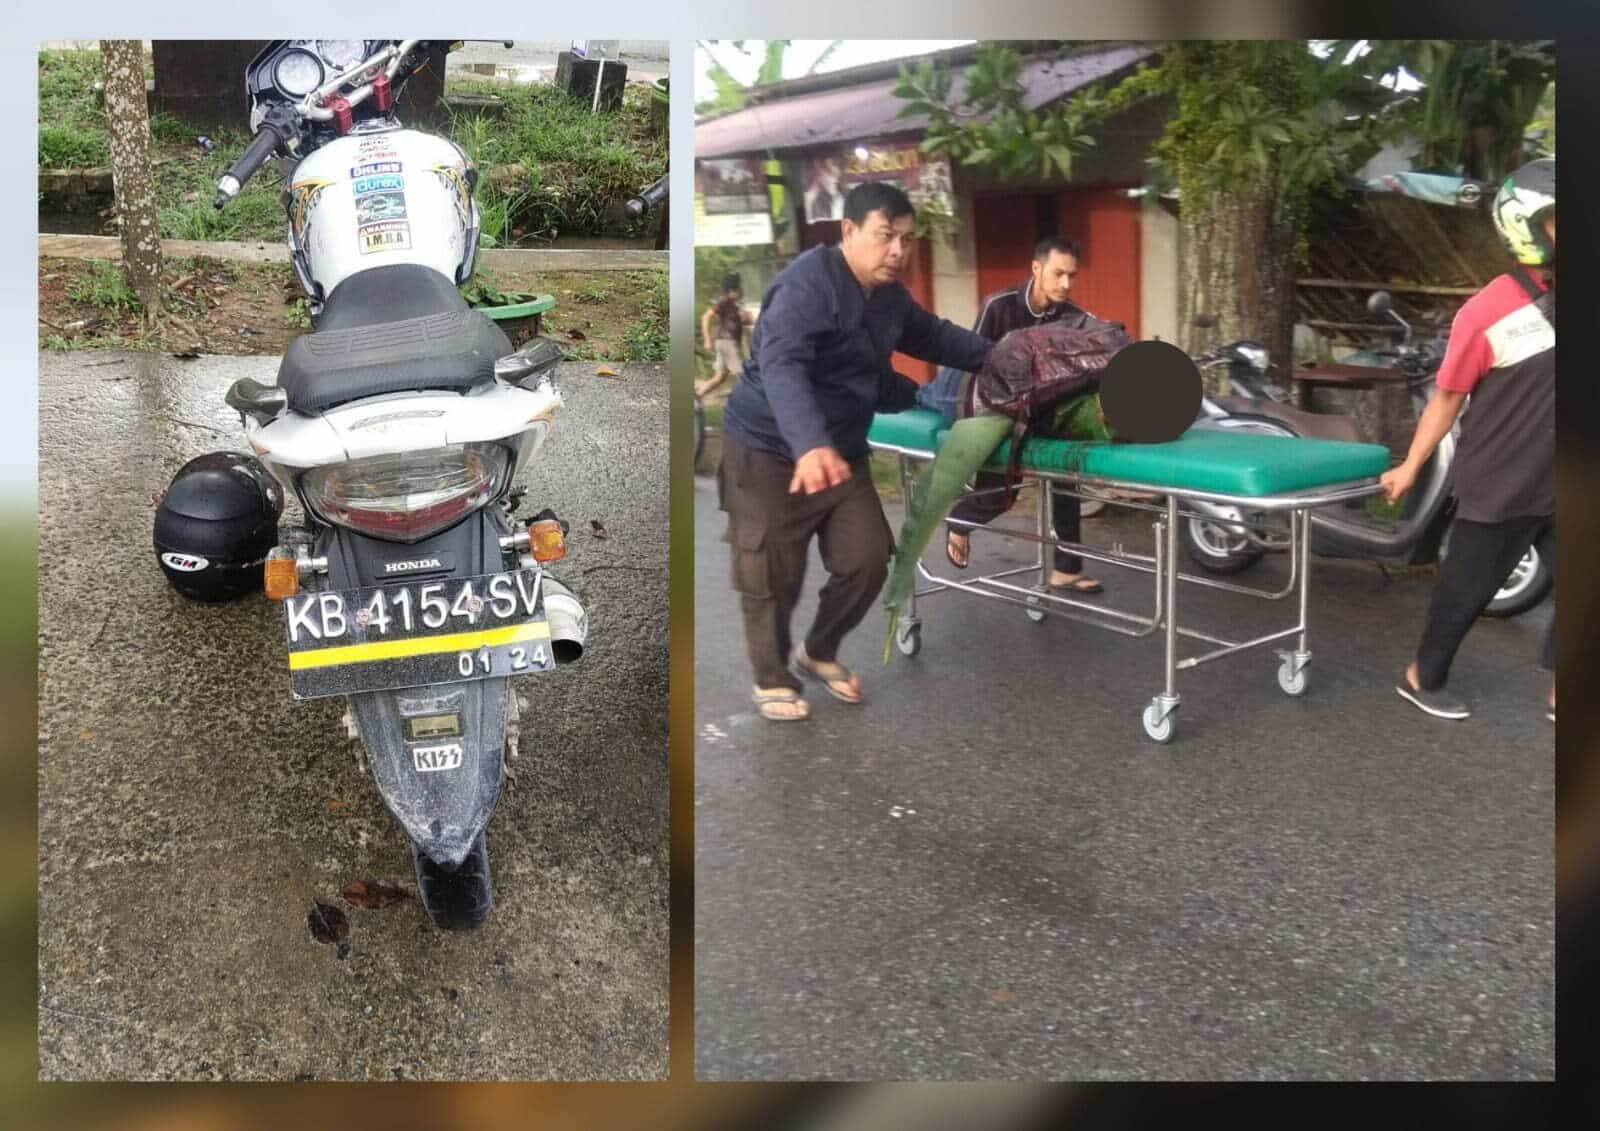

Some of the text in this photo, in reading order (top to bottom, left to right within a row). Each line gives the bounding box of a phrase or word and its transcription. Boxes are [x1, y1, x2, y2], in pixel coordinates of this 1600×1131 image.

[170, 556, 198, 569] GM
[385, 559, 441, 572] HONDA
[285, 571, 542, 642] KB 4154 SV
[457, 645, 548, 677] 01 24
[416, 749, 460, 769] KISS
